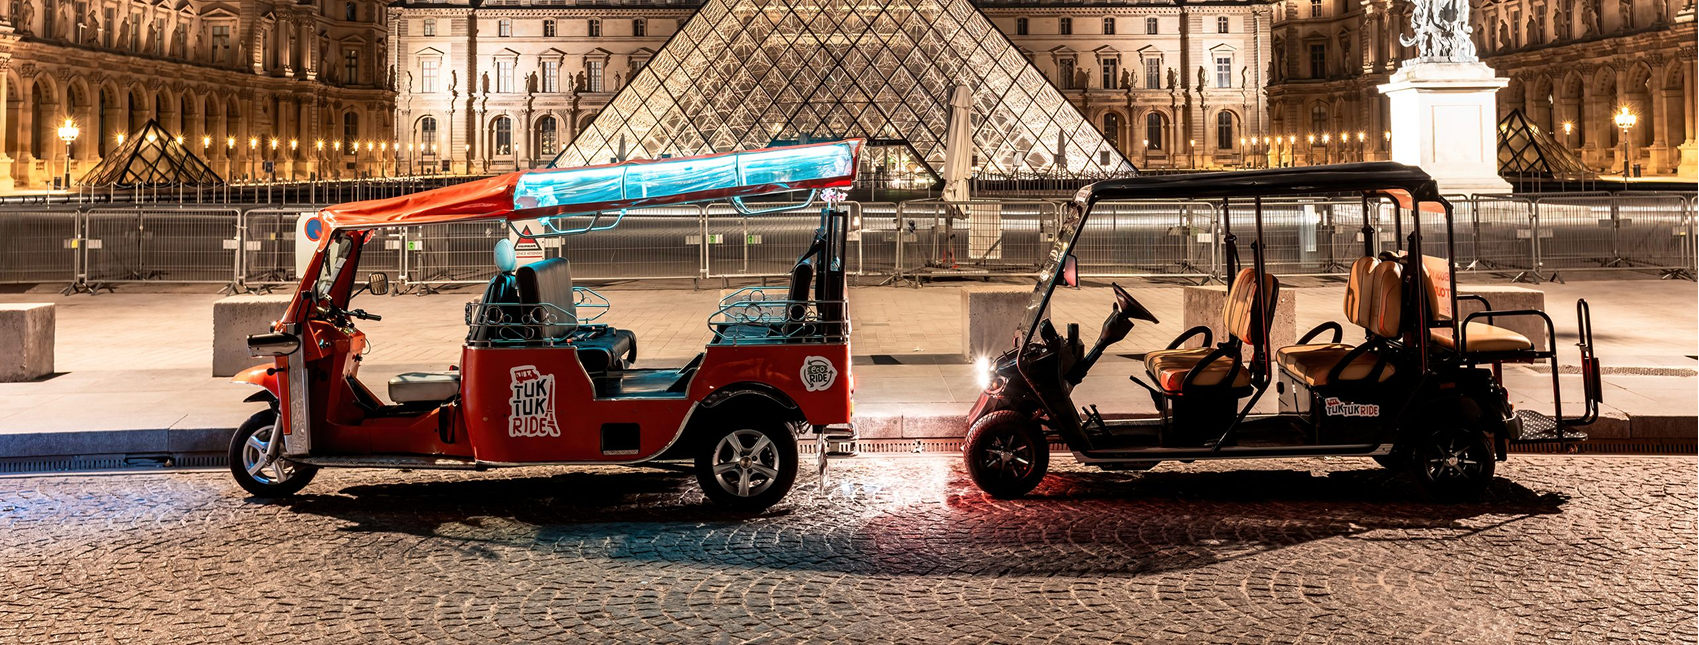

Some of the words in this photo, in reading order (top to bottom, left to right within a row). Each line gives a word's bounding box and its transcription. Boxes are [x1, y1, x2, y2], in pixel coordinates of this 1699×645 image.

[810, 374, 828, 383] RIDE
[514, 379, 547, 400] TUK
[513, 398, 547, 417] TUK
[513, 416, 547, 434] RIDE
